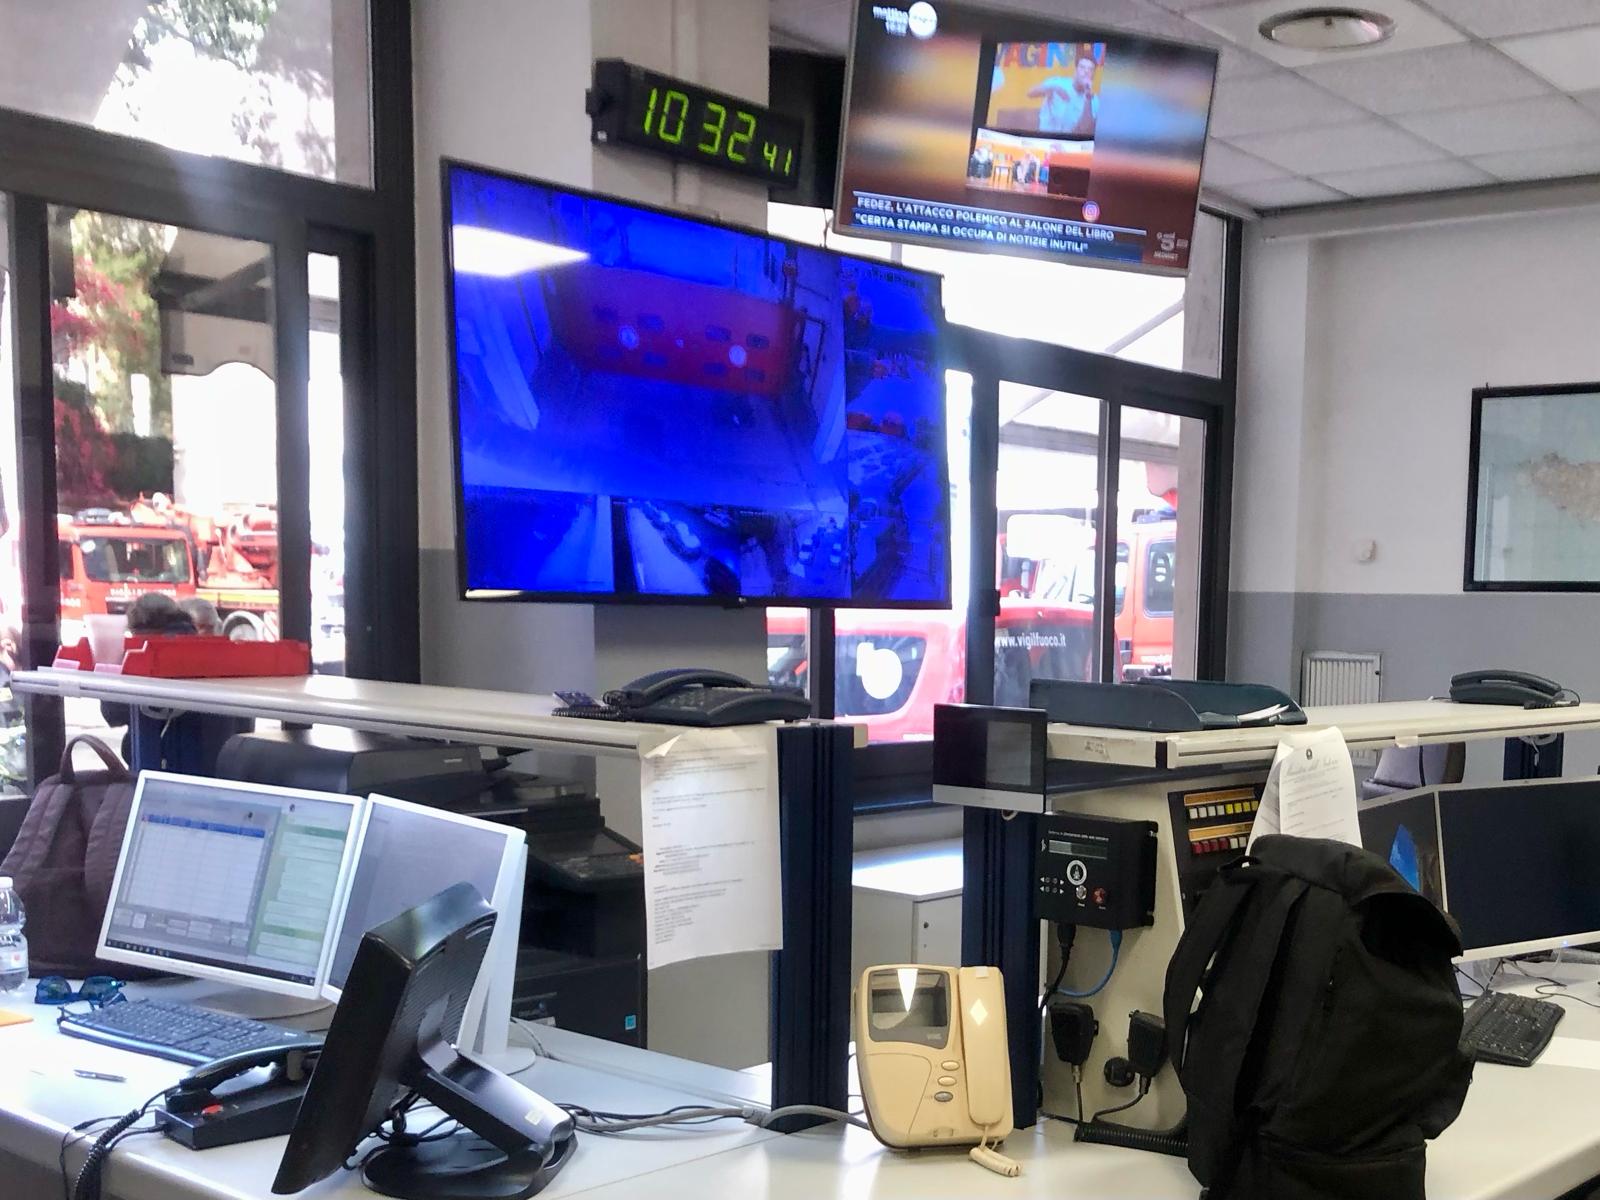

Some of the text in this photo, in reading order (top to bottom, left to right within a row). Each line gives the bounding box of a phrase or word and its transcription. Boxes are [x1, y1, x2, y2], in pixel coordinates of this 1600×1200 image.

[643, 87, 793, 176] 10 32 41
[855, 212, 1089, 253] "CERTA STAMPA SI OCCUPA DI NOTIZIE INUTILI"
[857, 196, 1115, 241] FEDEZ, L'ATTACCO POLEMICO AL SALONE DEL LIBRO
